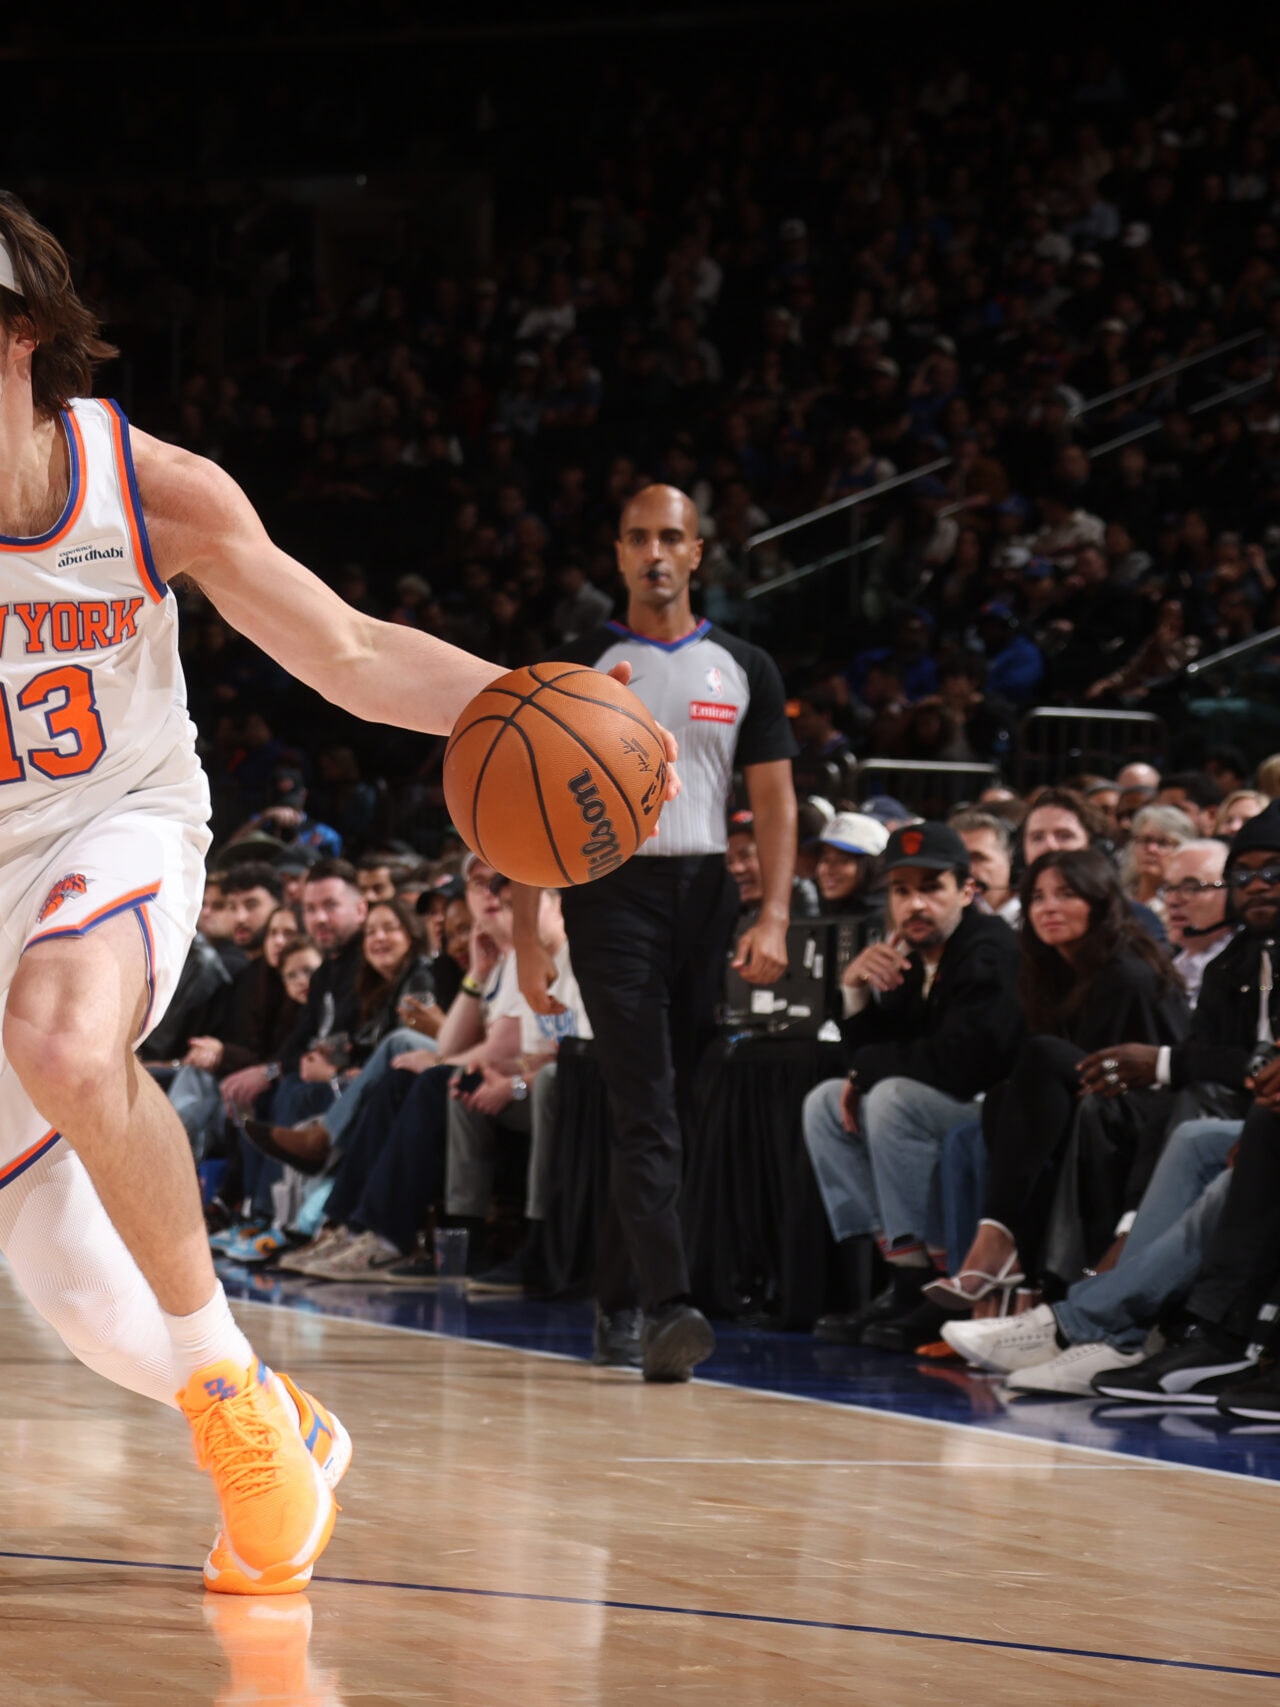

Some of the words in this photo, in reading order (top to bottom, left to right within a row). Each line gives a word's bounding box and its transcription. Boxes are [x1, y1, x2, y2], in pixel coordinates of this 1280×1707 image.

[58, 556, 83, 567] abu
[84, 546, 124, 560] dhabi
[14, 598, 144, 653] YORK
